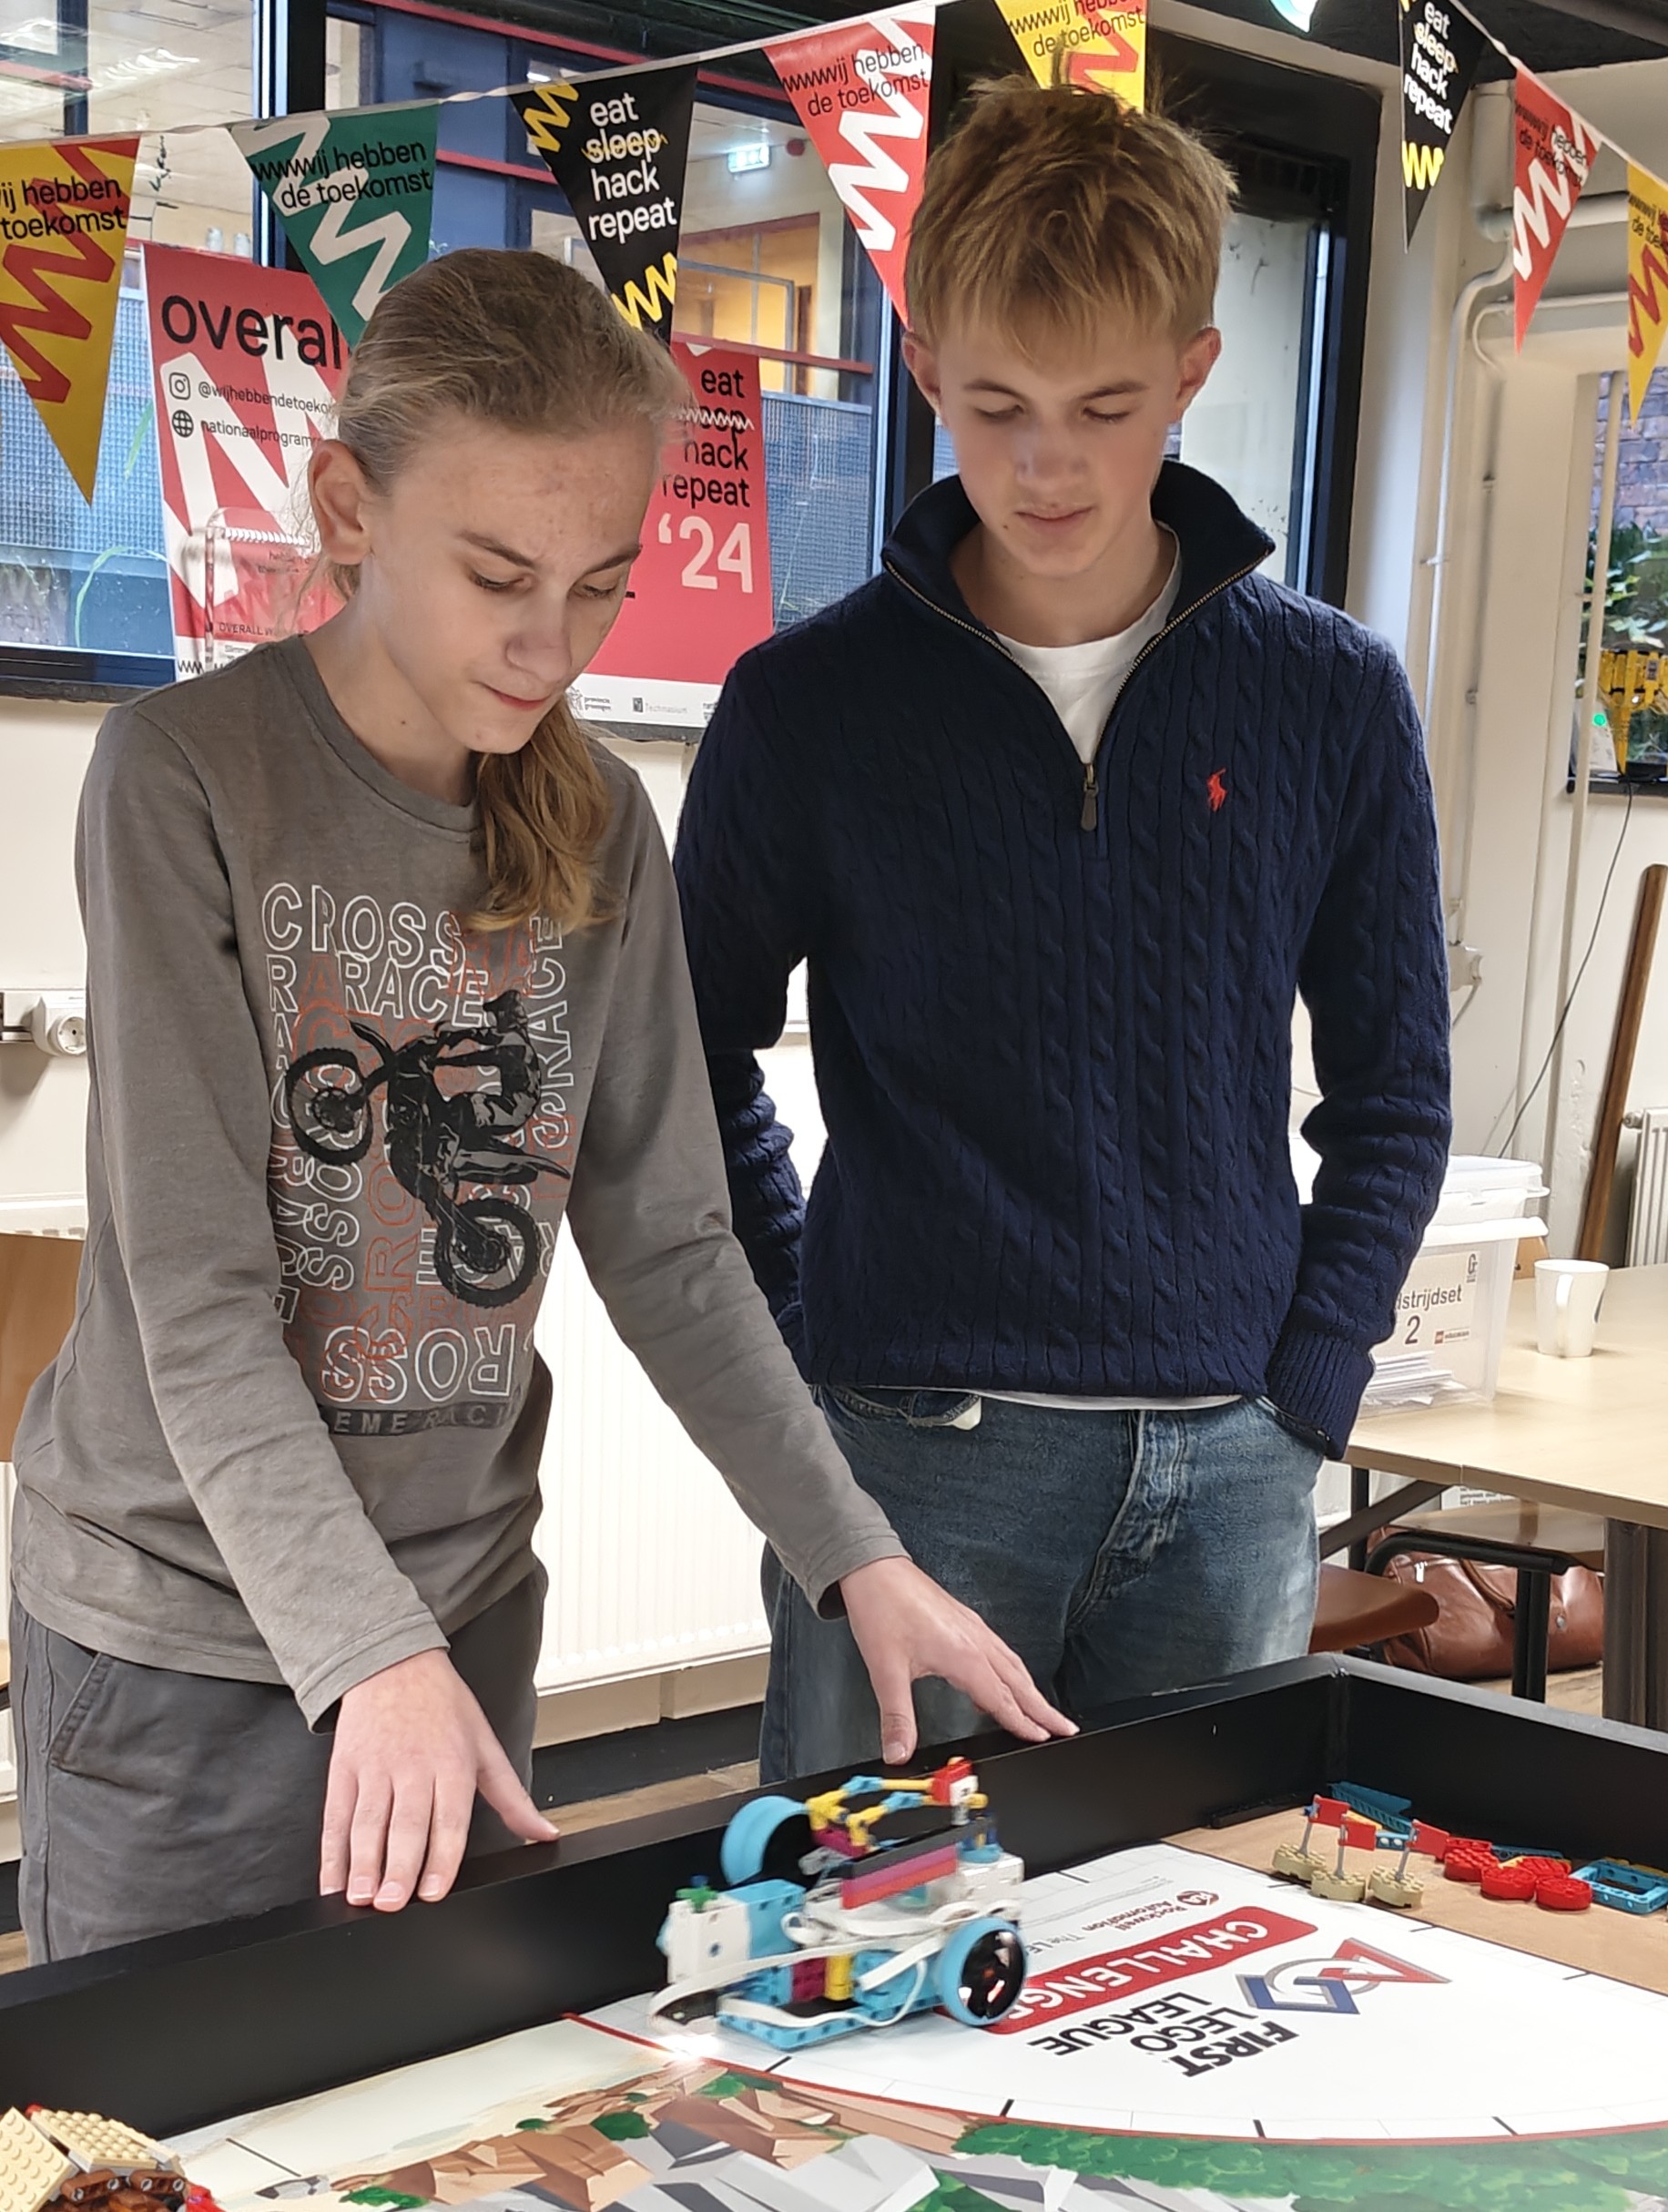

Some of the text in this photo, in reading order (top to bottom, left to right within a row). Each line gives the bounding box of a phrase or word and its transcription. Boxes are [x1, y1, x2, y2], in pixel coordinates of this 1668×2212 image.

[1033, 5, 1145, 57] de toekomst
[1424, 2, 1450, 40] eat
[851, 43, 924, 77] hebben
[1411, 43, 1448, 100] hack
[590, 92, 639, 127] eat
[808, 69, 929, 117] de toekomst
[1404, 73, 1453, 135] repeat
[333, 142, 427, 171] hebben
[585, 127, 661, 163] sleep
[21, 176, 121, 206] hebben
[281, 168, 433, 209] de toekomst
[592, 159, 660, 201] hack
[0, 206, 127, 240] toekomst
[588, 197, 677, 244] repeat
[161, 295, 351, 370] overal
[198, 381, 331, 415] @wijhebbendetoeko
[700, 369, 745, 398] eat
[662, 472, 750, 509] repeat
[338, 950, 490, 1029] RACE
[1405, 1315, 1420, 1345] 2
[321, 1323, 535, 1403] ROSS
[1026, 1992, 1213, 2056] LEAGUE
[1130, 2007, 1258, 2053] LEGO
[1169, 2020, 1300, 2078] FIRST
